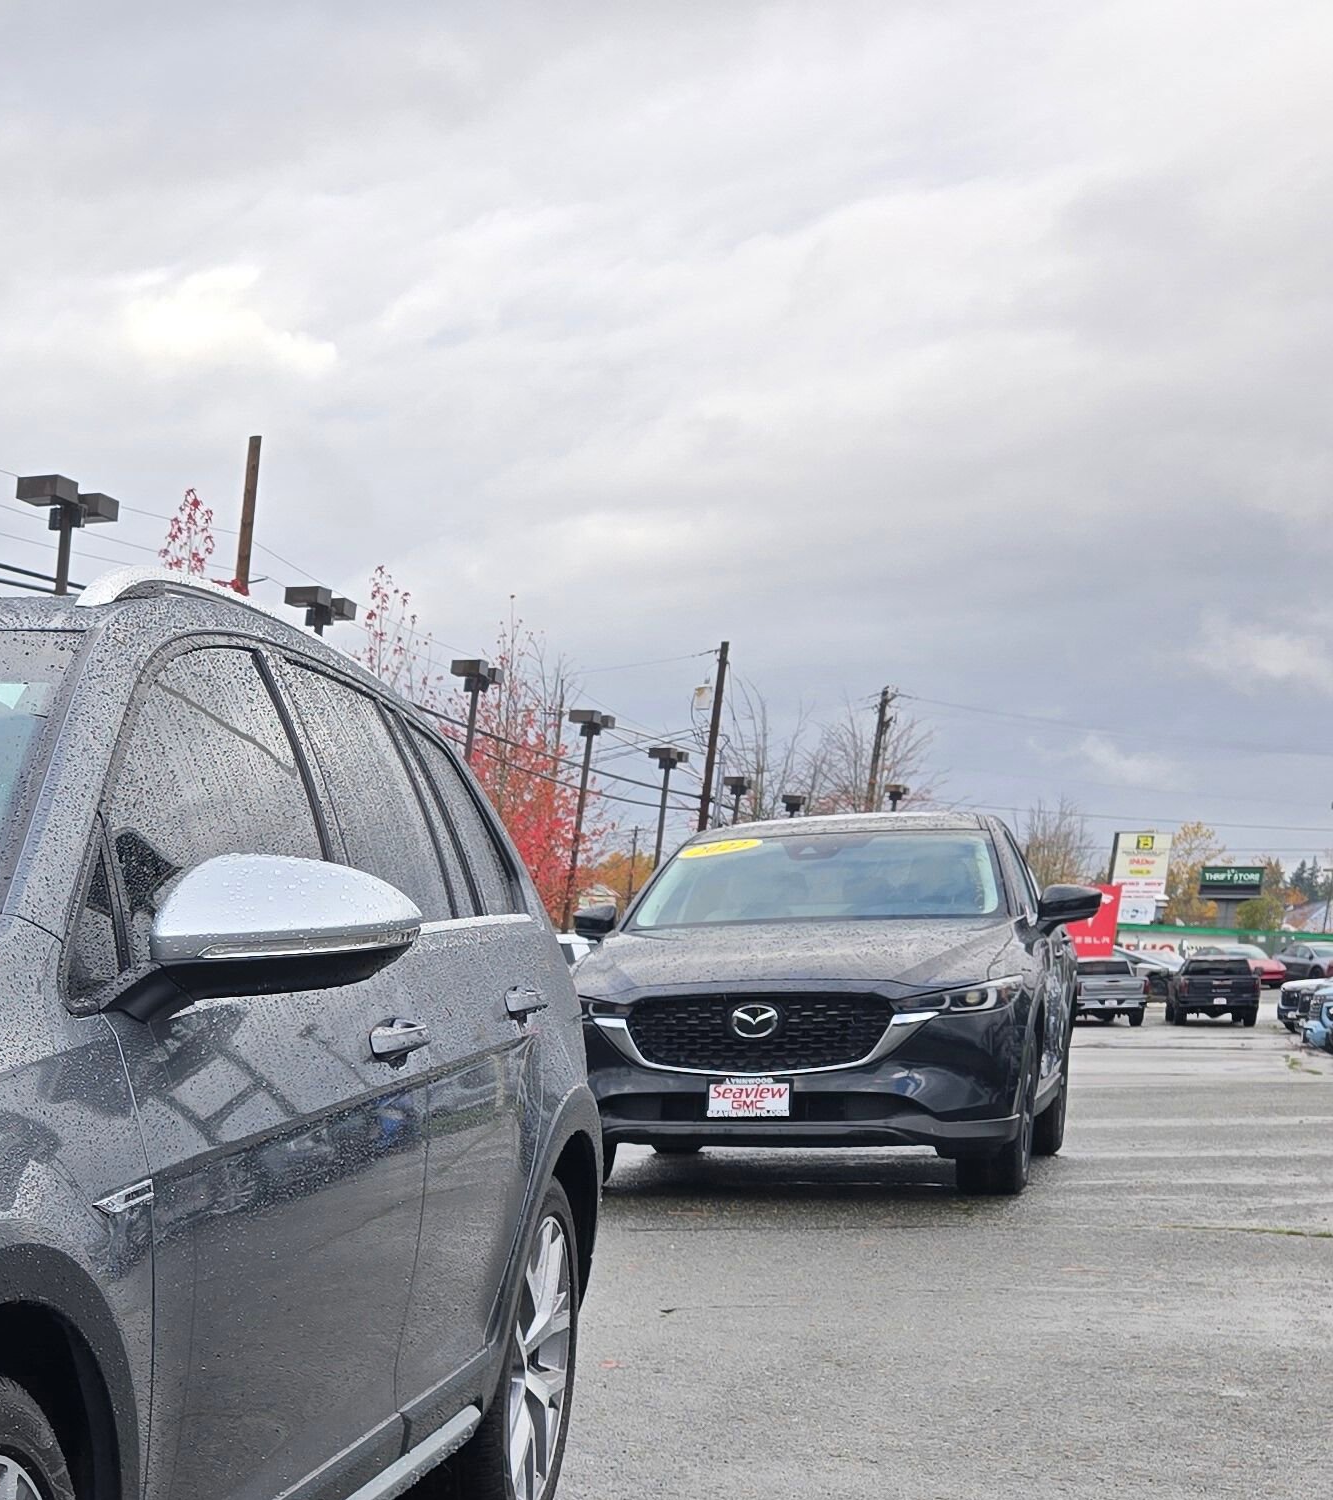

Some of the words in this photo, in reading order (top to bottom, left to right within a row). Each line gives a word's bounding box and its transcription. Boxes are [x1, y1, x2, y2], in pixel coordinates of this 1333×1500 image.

[1204, 869, 1232, 881] THRIFT
[1074, 935, 1110, 945] ESLA
[710, 1084, 788, 1099] Seaview
[731, 1100, 766, 1110] GMC
